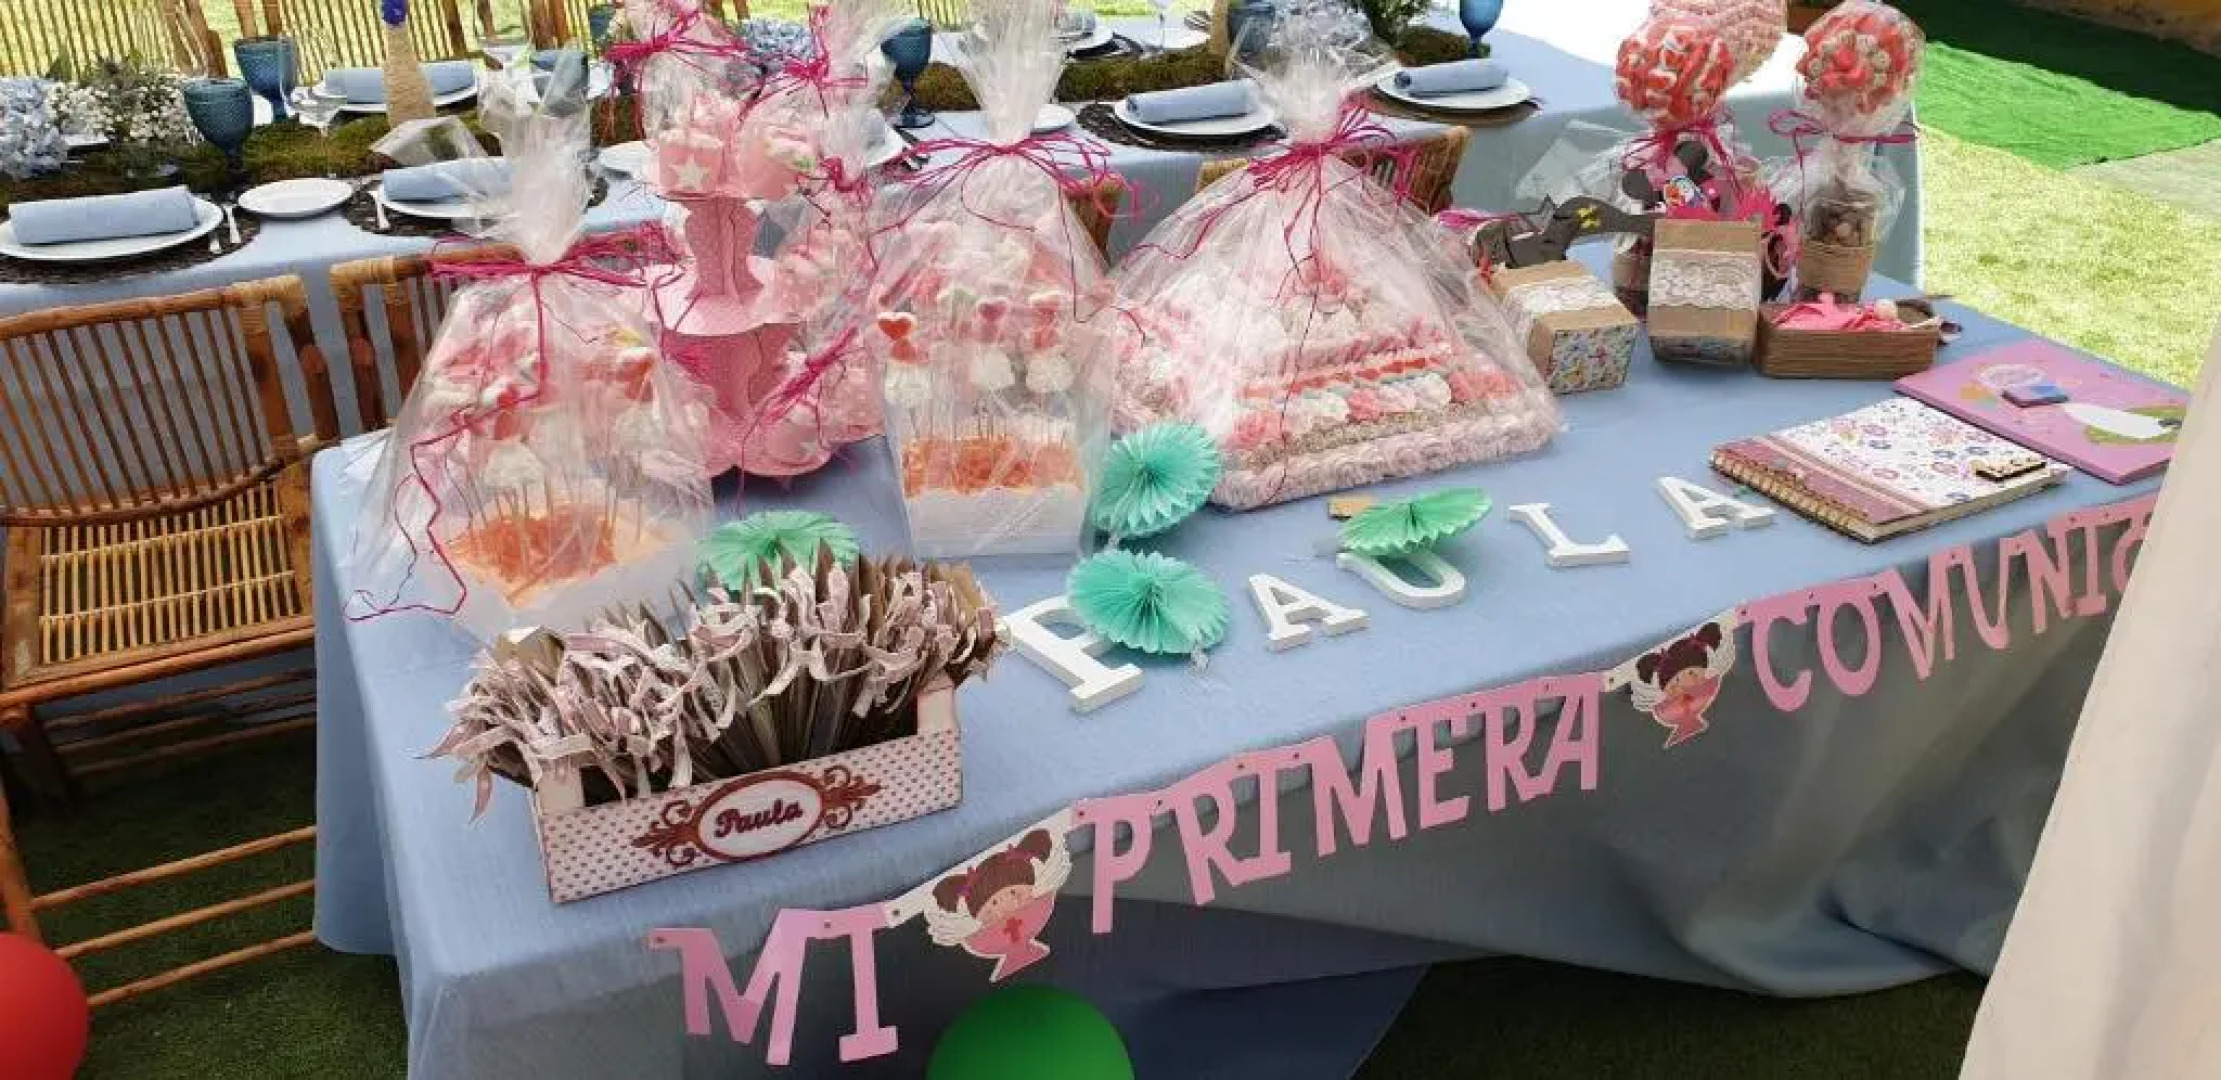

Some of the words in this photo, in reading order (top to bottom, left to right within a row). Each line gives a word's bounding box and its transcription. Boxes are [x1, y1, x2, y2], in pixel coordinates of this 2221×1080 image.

[648, 903, 899, 1066] MI
[1072, 670, 1600, 934] PRIMERA
[714, 798, 804, 838] Paula
